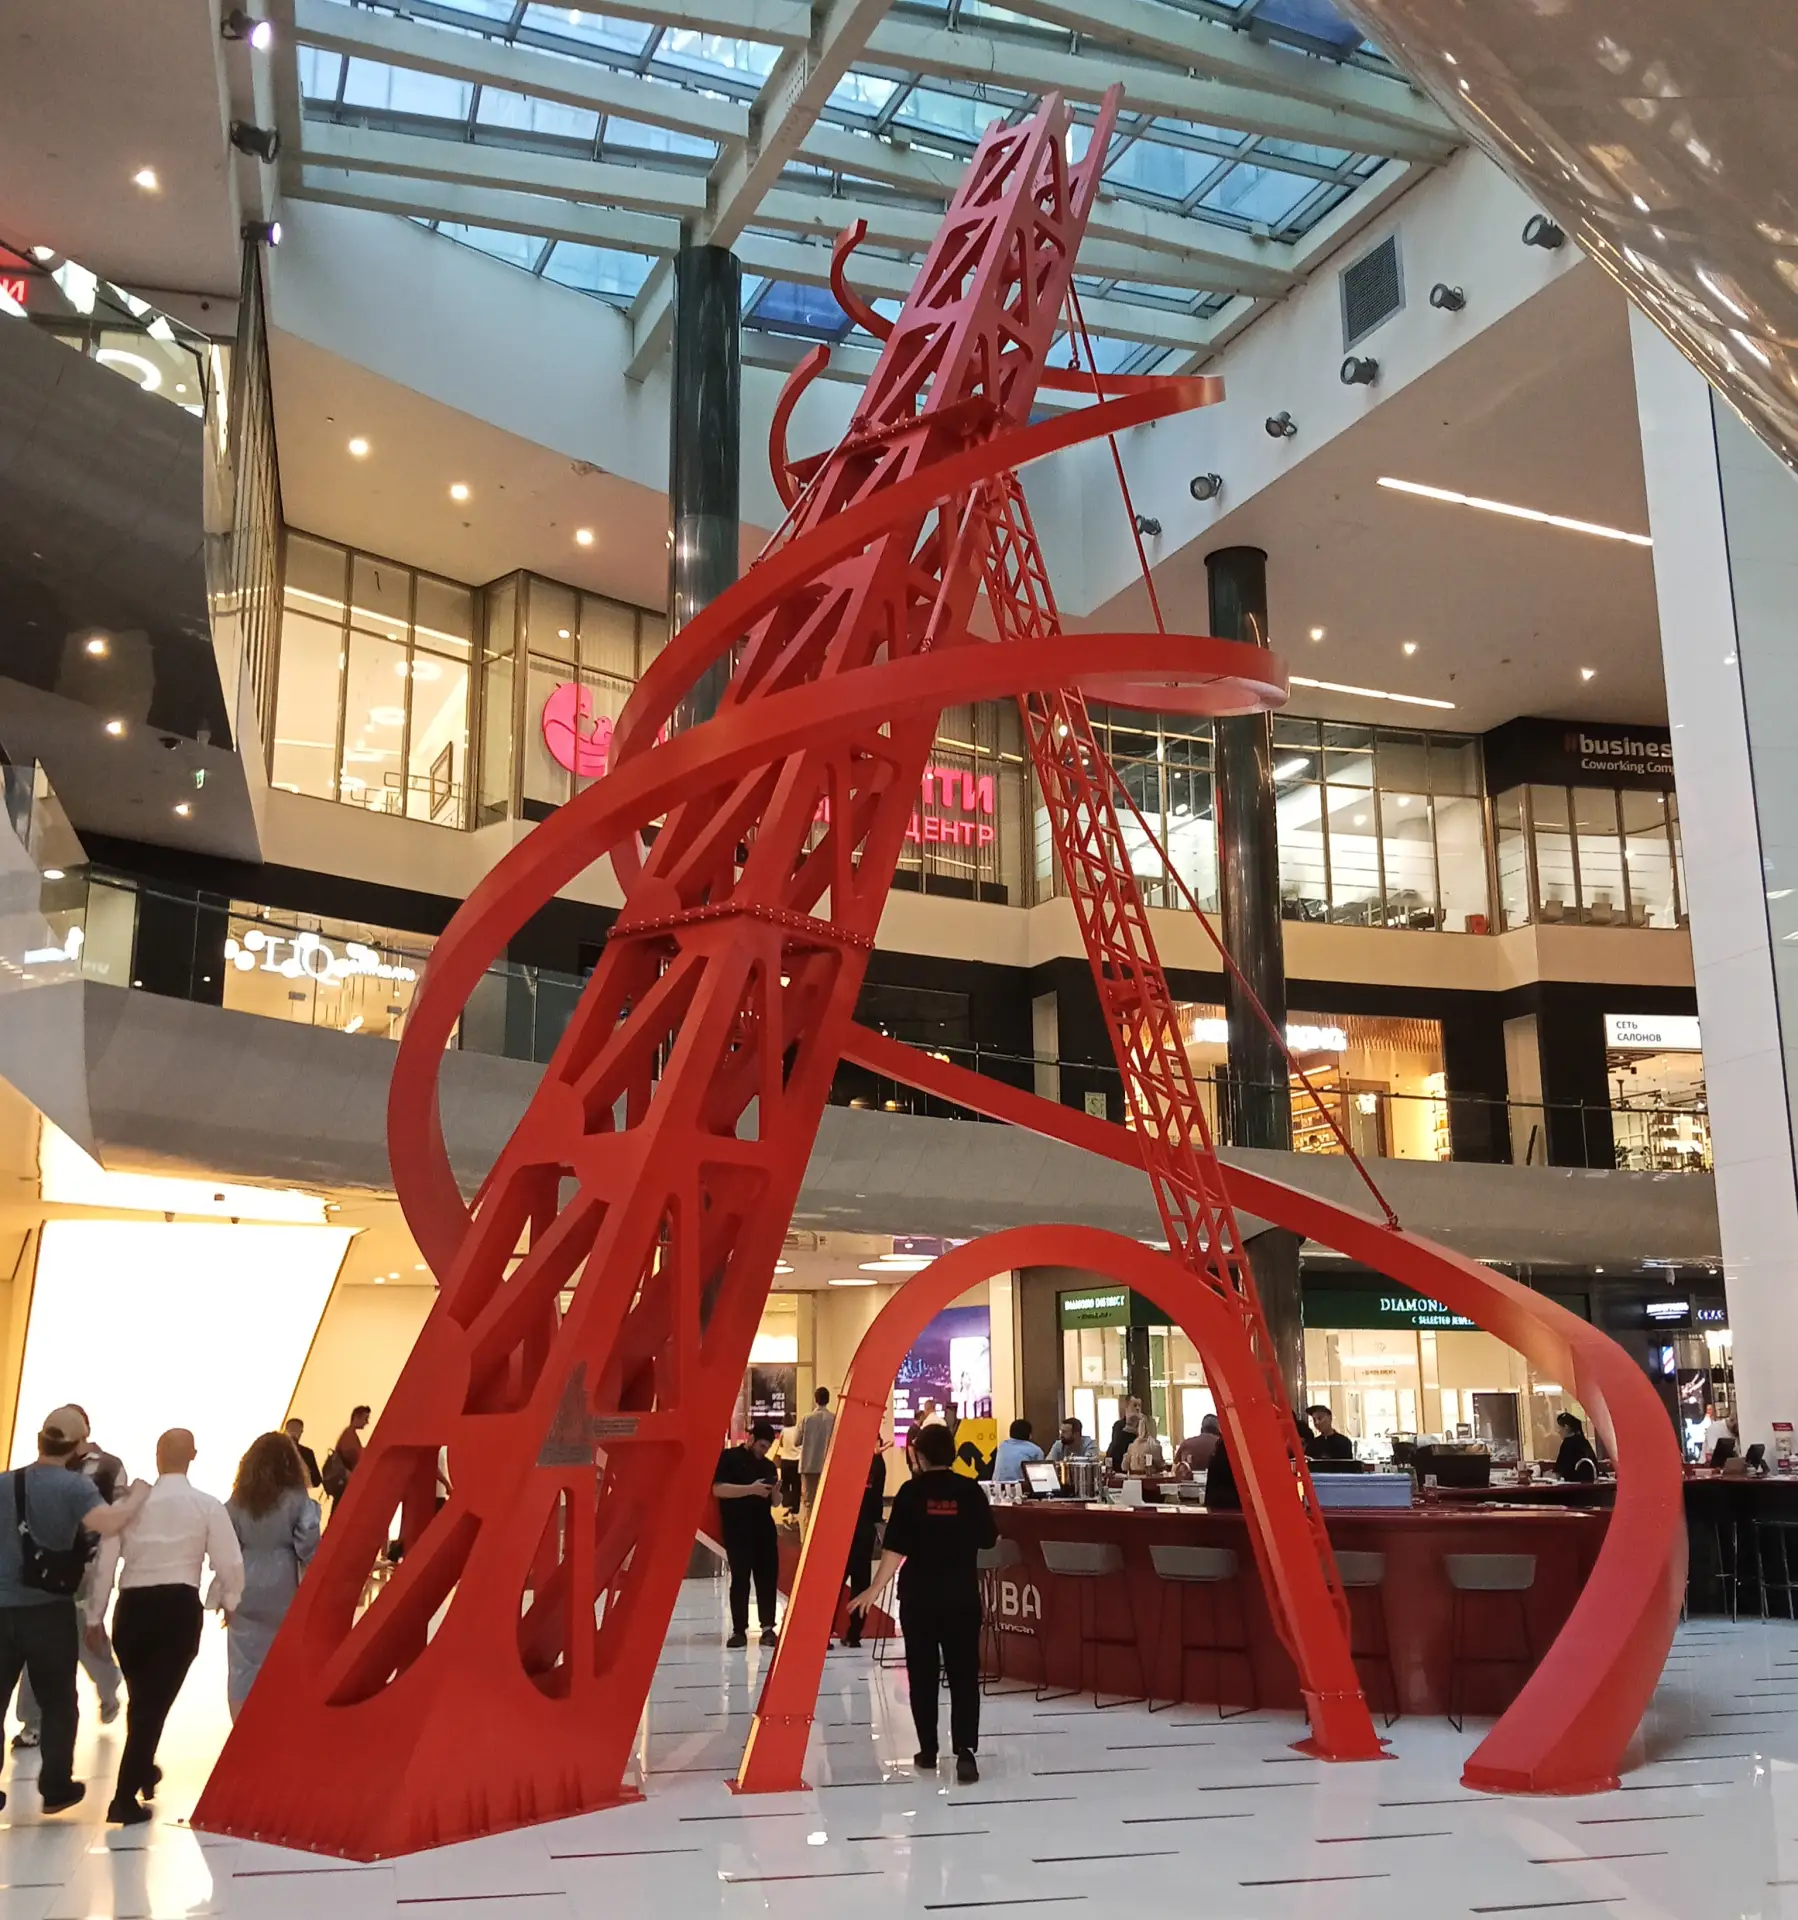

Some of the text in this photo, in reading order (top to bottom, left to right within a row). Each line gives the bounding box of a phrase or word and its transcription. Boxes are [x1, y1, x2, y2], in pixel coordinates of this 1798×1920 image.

[1581, 758, 1645, 774] Coworking
[1616, 1021, 1638, 1030] СЕТЬ
[1617, 1033, 1662, 1042] САЛОНОВ
[1418, 1315, 1451, 1325] SELECTED
